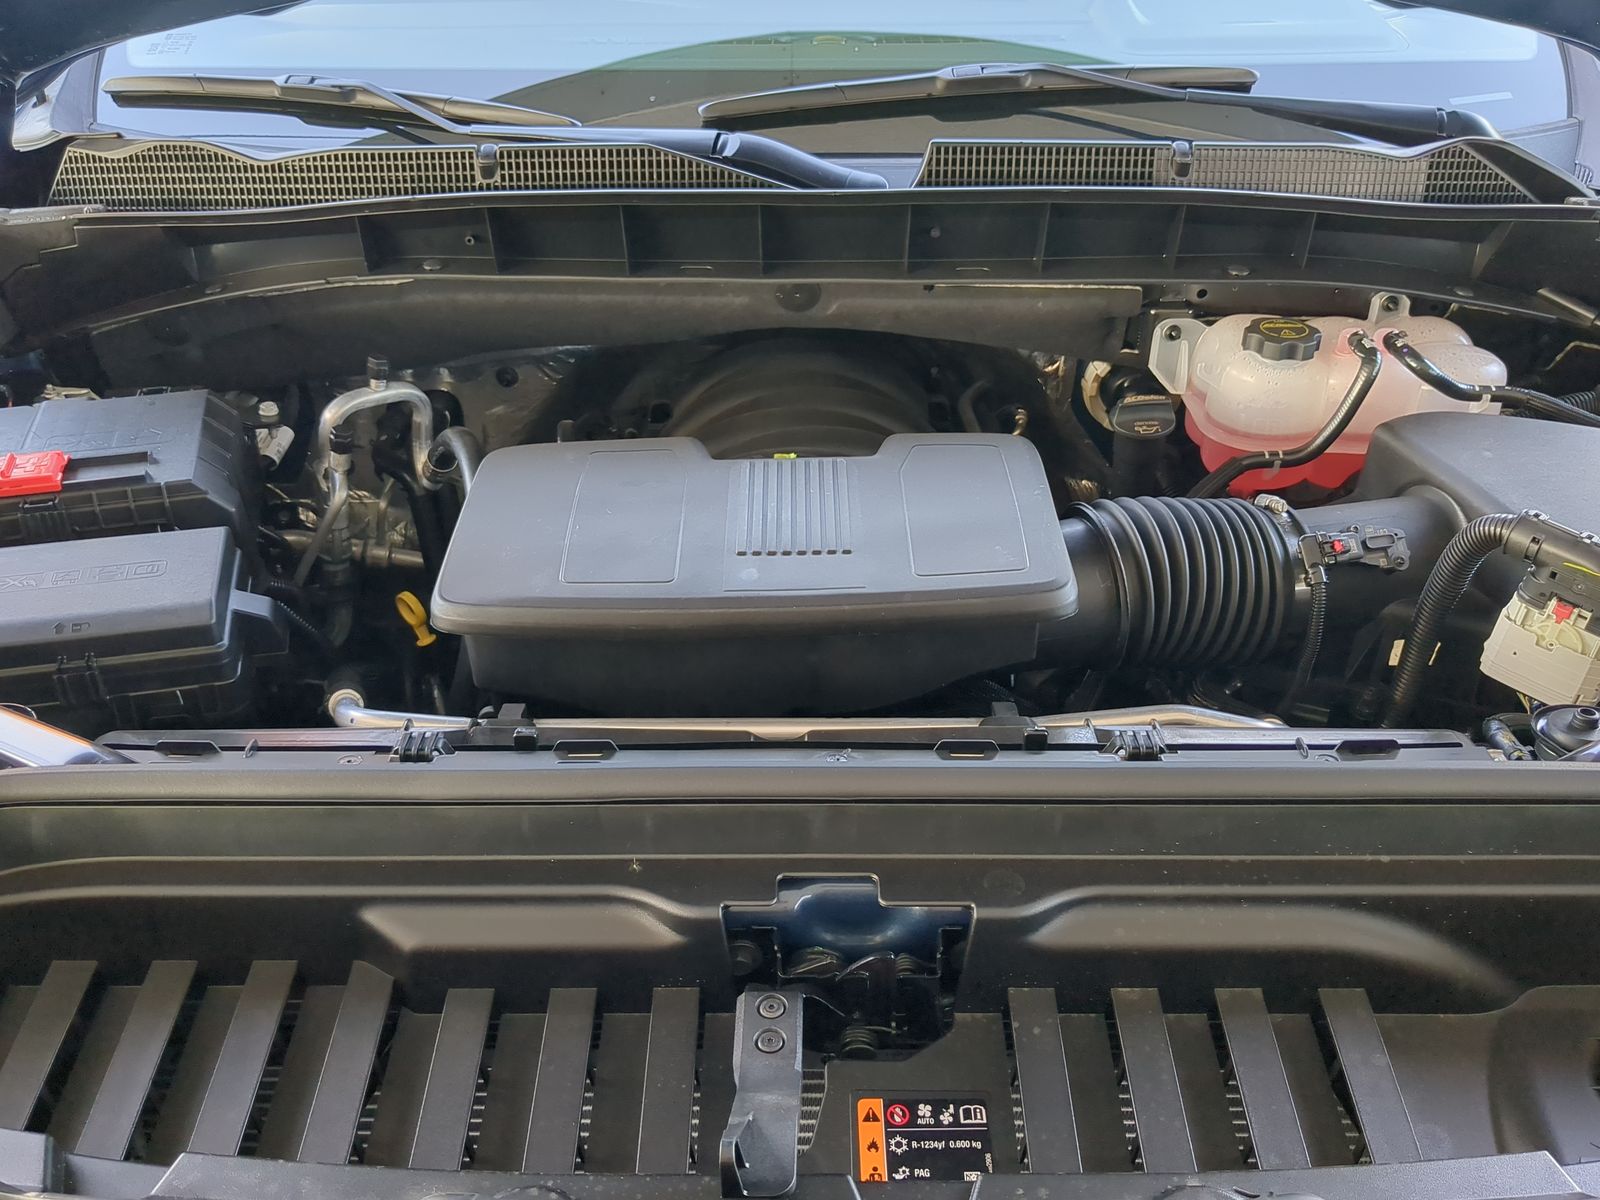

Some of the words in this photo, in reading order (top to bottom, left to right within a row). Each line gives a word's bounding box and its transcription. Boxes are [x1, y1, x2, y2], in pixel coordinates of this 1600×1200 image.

[911, 1140, 945, 1149] R-1234yf
[949, 1140, 970, 1148] 0.600
[971, 1140, 981, 1149] kg
[914, 1168, 930, 1177] PAG
